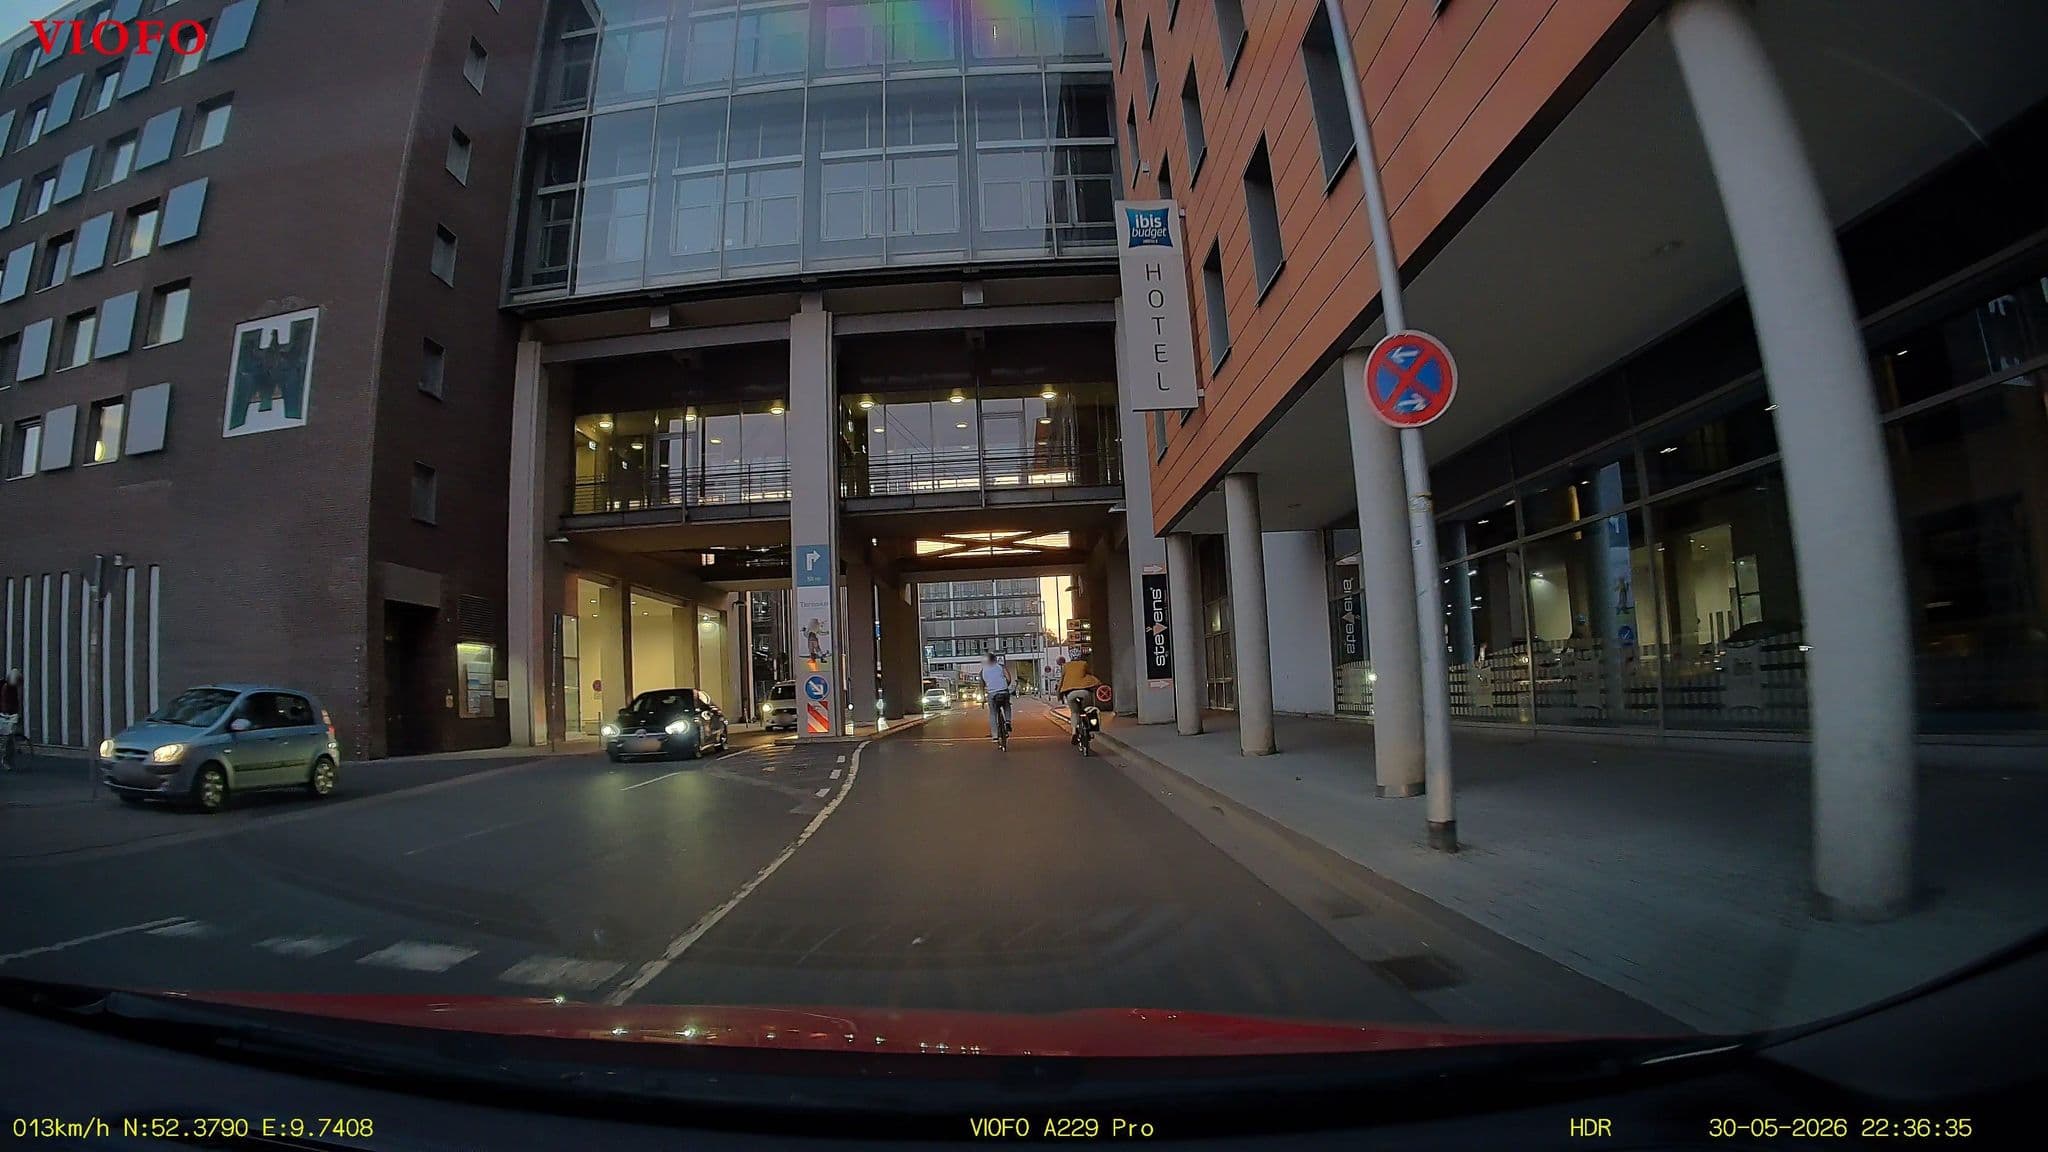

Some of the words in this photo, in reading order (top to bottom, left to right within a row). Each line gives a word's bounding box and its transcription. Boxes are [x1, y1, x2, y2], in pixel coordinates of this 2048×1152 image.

[1131, 227, 1168, 240] budget
[1135, 213, 1162, 228] ibis
[1145, 263, 1170, 391] HOTEL
[1152, 587, 1168, 667] stevens
